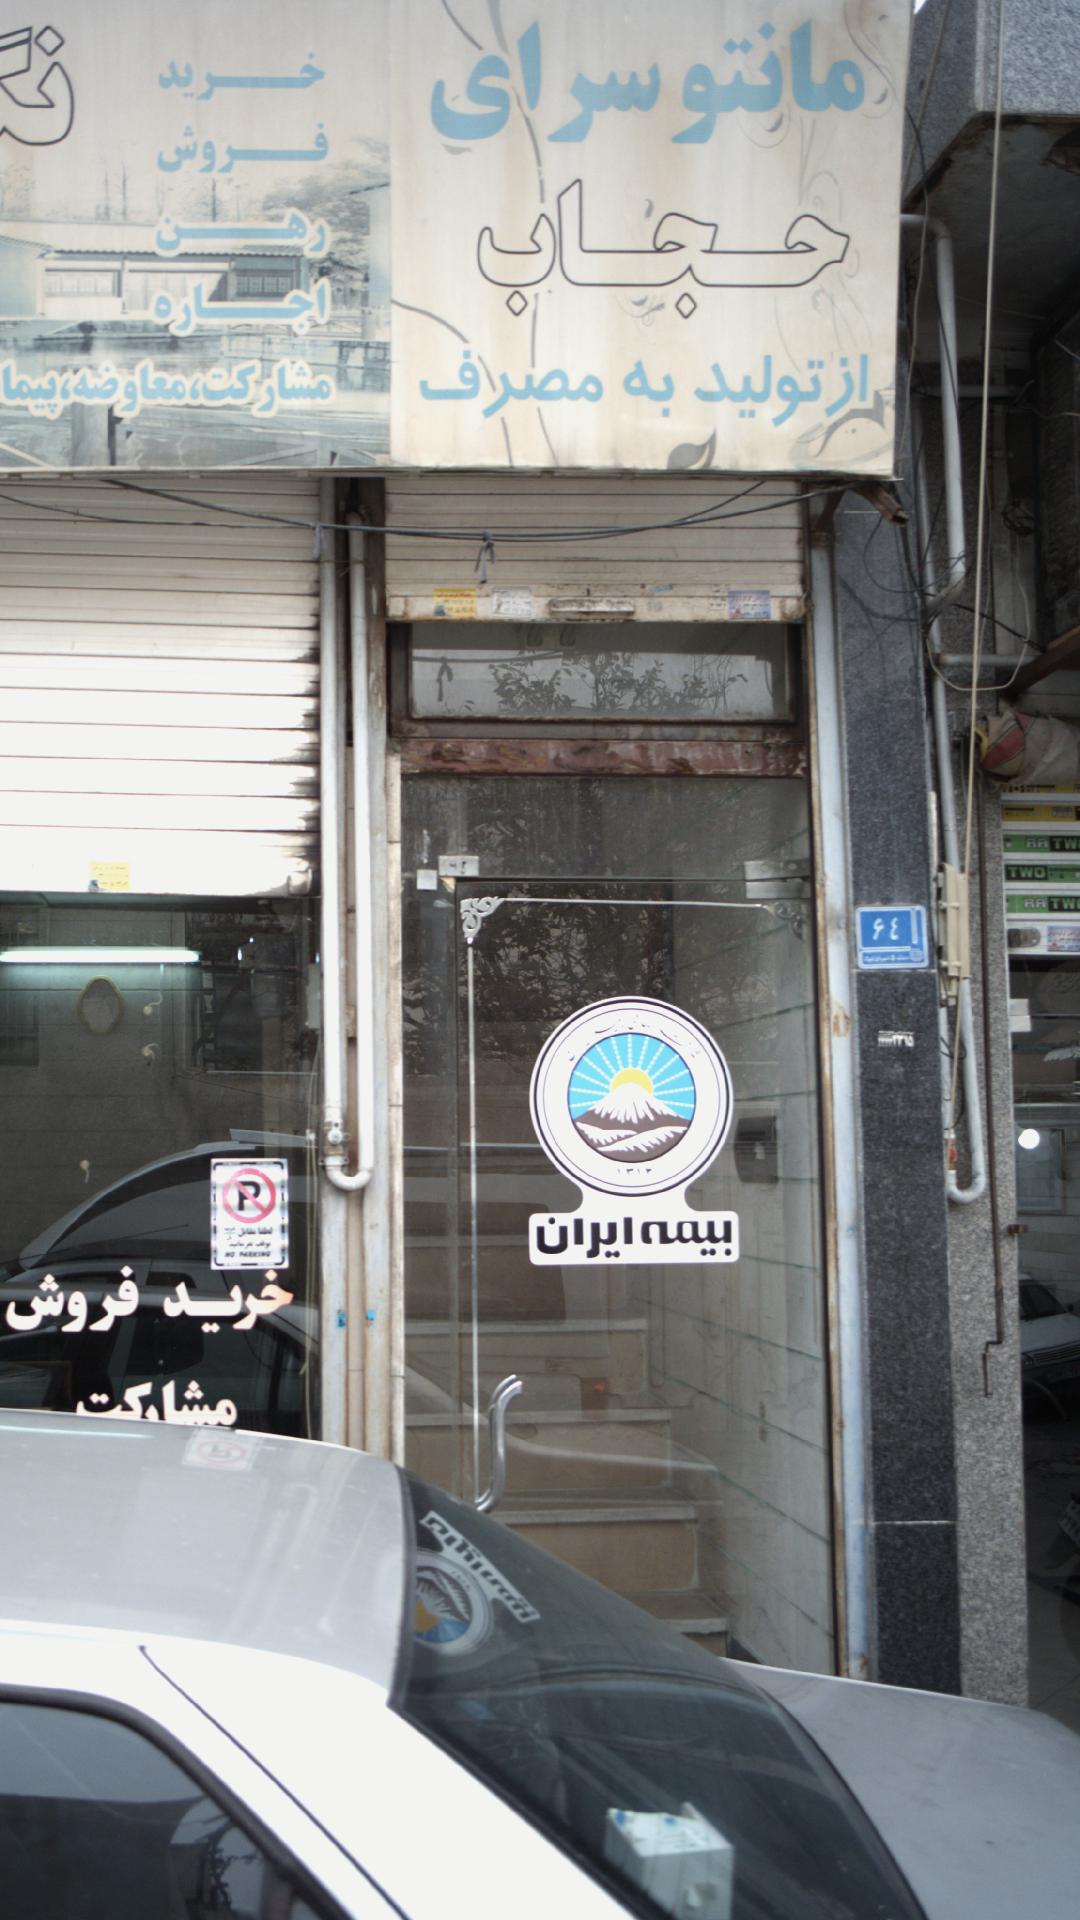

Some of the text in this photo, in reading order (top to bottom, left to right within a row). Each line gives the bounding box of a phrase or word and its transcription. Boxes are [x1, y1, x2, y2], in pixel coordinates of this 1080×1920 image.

[158, 52, 326, 100] خرید
[157, 122, 330, 173] فروش
[155, 210, 325, 252] رهن
[477, 178, 850, 319] حجاب
[154, 283, 327, 333] اجاره
[419, 348, 869, 426] از تولید به مصرف
[1007, 866, 1046, 878] TWO
[535, 1216, 733, 1260] بیمه ایران
[5, 1264, 294, 1333] خرید فروش
[76, 1379, 238, 1426] مشارکت
